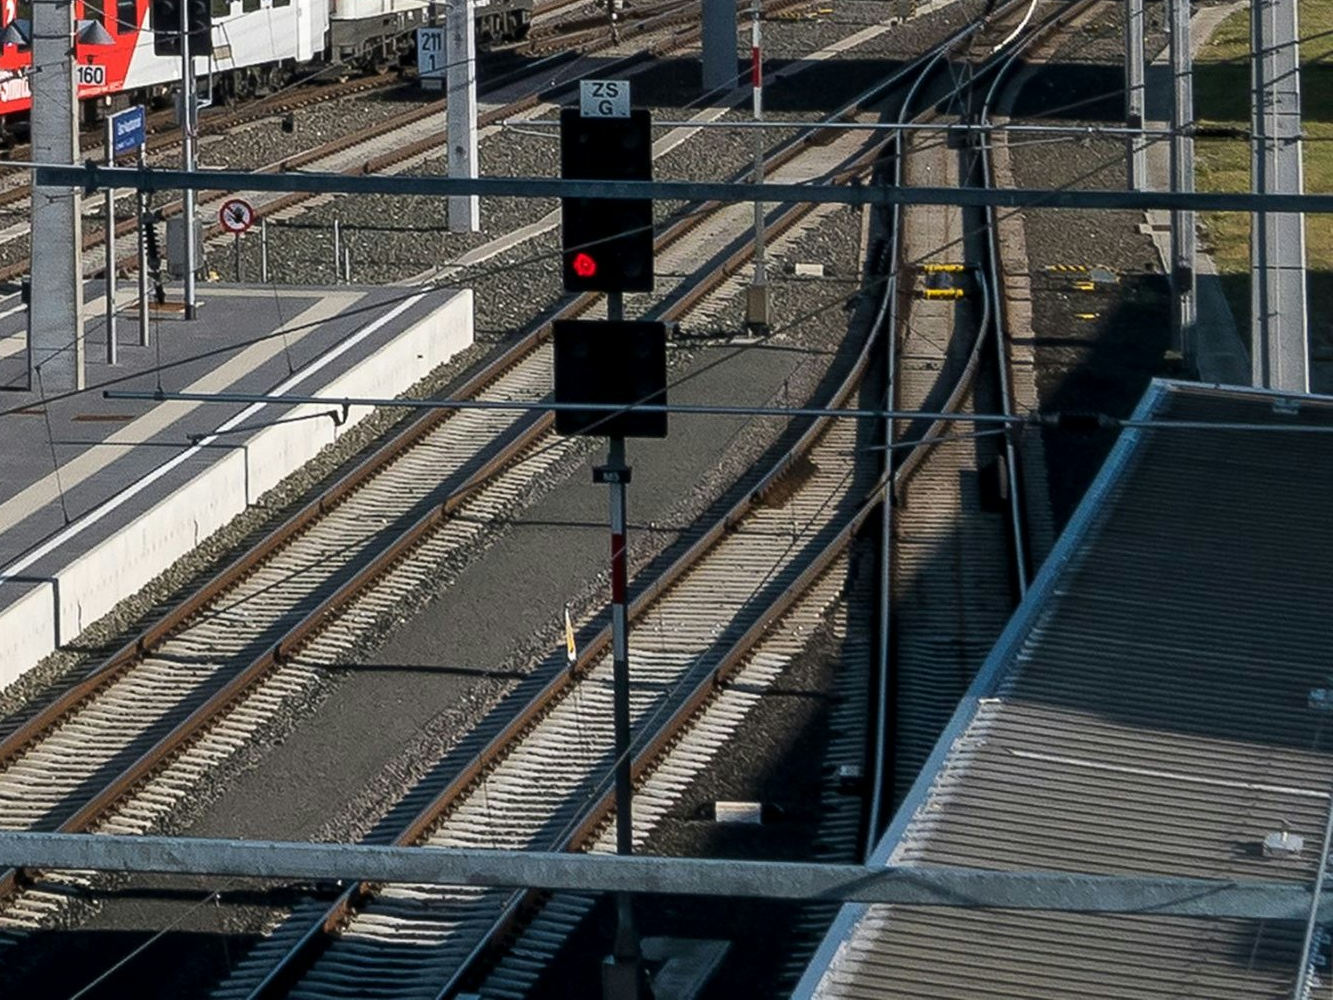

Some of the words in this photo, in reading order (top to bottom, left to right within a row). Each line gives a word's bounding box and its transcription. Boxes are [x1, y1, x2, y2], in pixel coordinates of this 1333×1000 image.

[422, 33, 442, 50] 211
[429, 54, 436, 71] 1
[77, 67, 104, 84] 160
[592, 82, 619, 98] ZS
[599, 100, 613, 116] G
